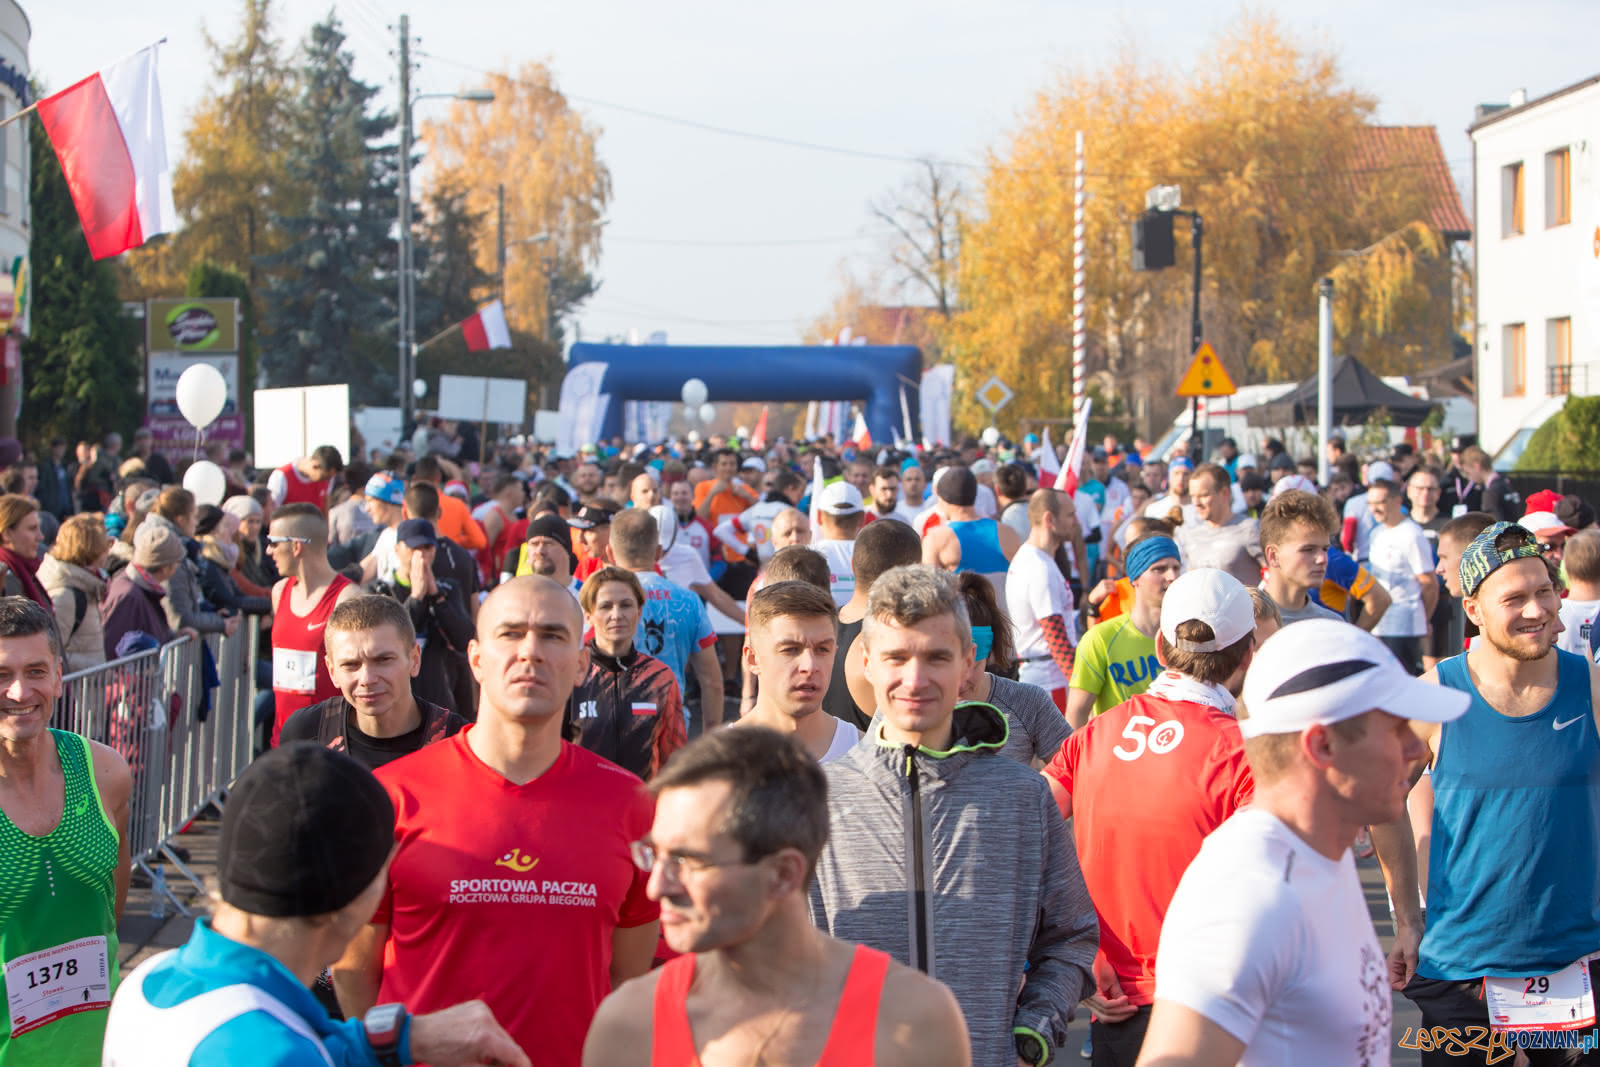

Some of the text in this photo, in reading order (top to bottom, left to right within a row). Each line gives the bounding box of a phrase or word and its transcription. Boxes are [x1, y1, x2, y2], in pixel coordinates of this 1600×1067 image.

[579, 700, 598, 718] SK
[1113, 715, 1184, 761] 50
[450, 879, 597, 896] SPORTOWA PACZKA
[450, 893, 596, 907] POCZTOWA GRUPA BIEGOWA
[27, 958, 78, 989] 1378
[1524, 977, 1549, 994] 29
